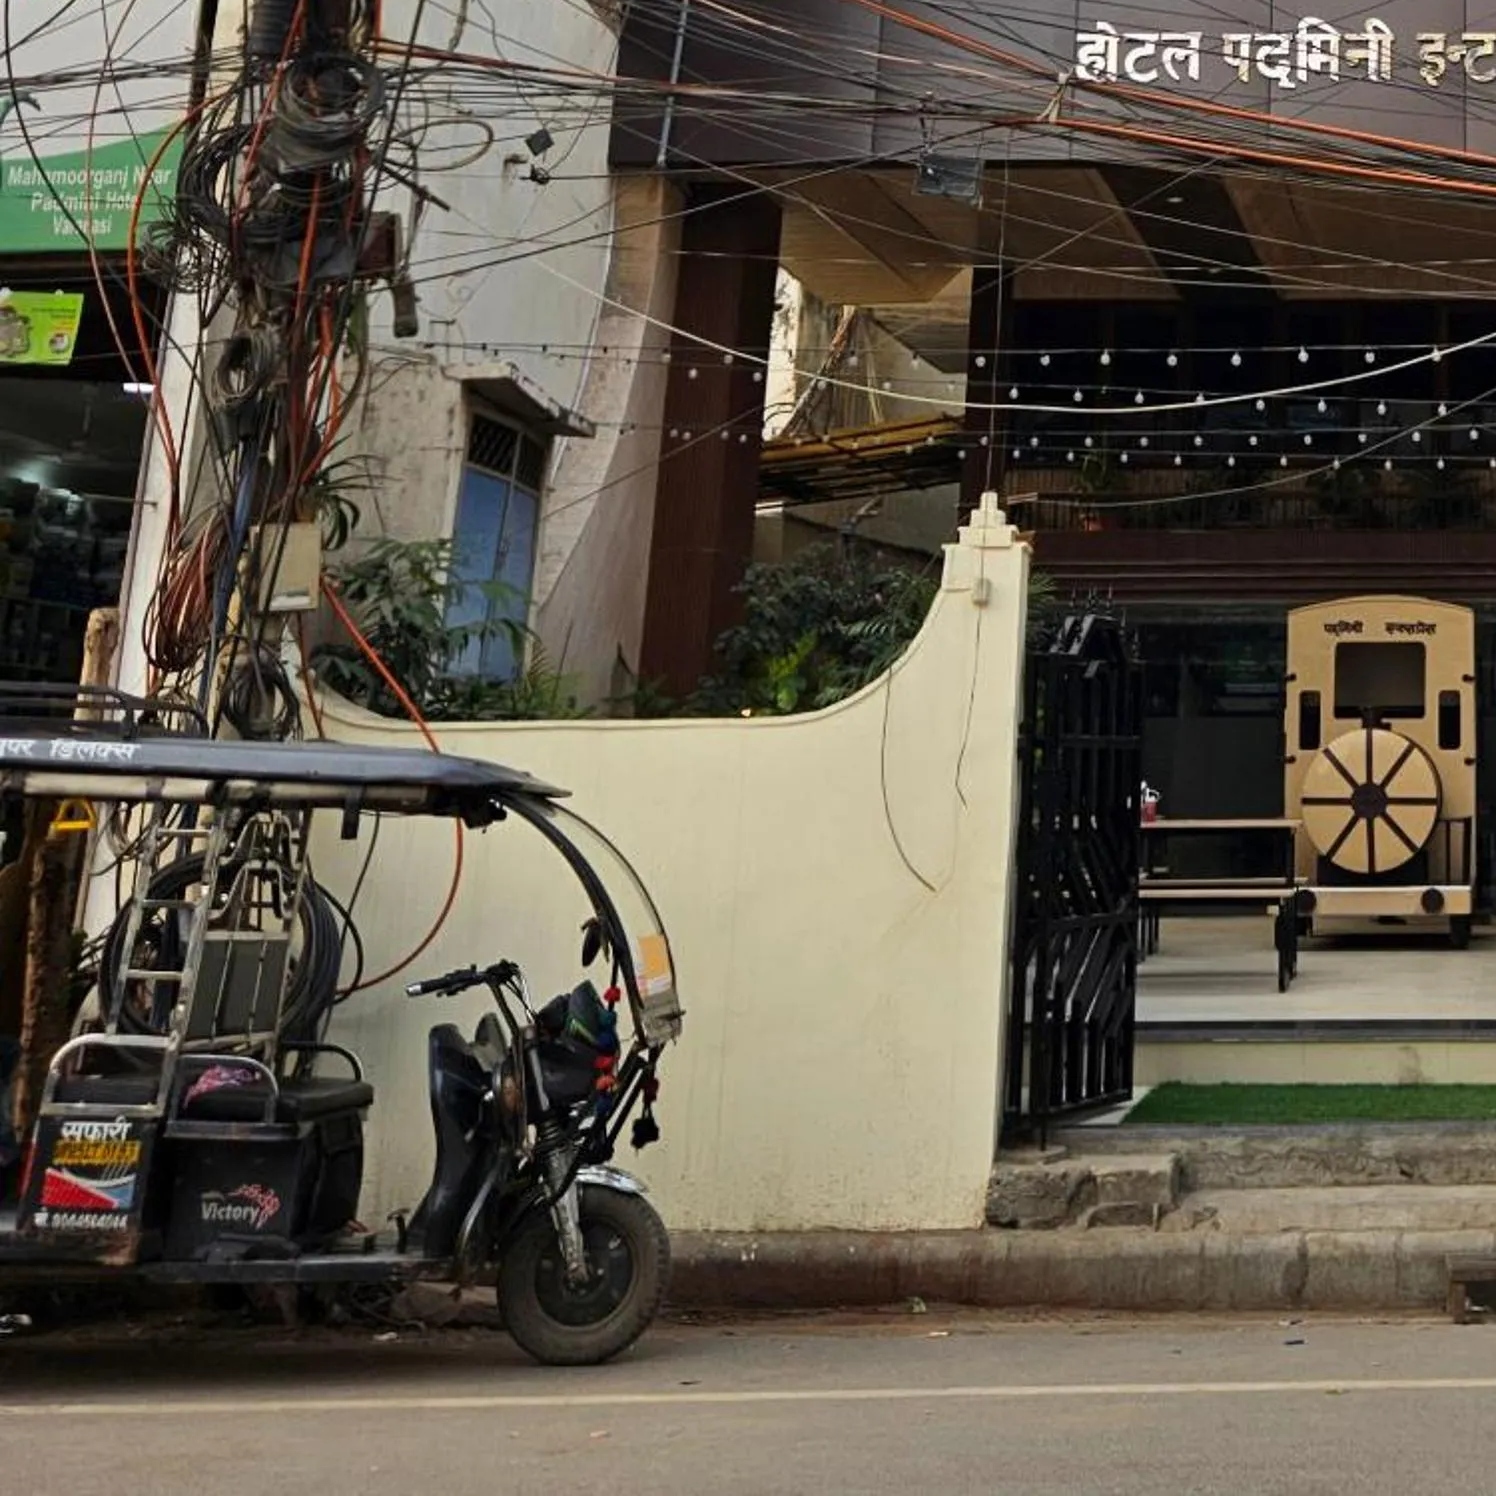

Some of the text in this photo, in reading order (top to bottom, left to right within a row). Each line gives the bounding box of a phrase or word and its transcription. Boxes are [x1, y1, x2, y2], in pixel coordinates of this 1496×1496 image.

[1075, 20, 1202, 83] होटल
[1222, 16, 1394, 89] पद्मिनी
[201, 1200, 260, 1227] Victory
